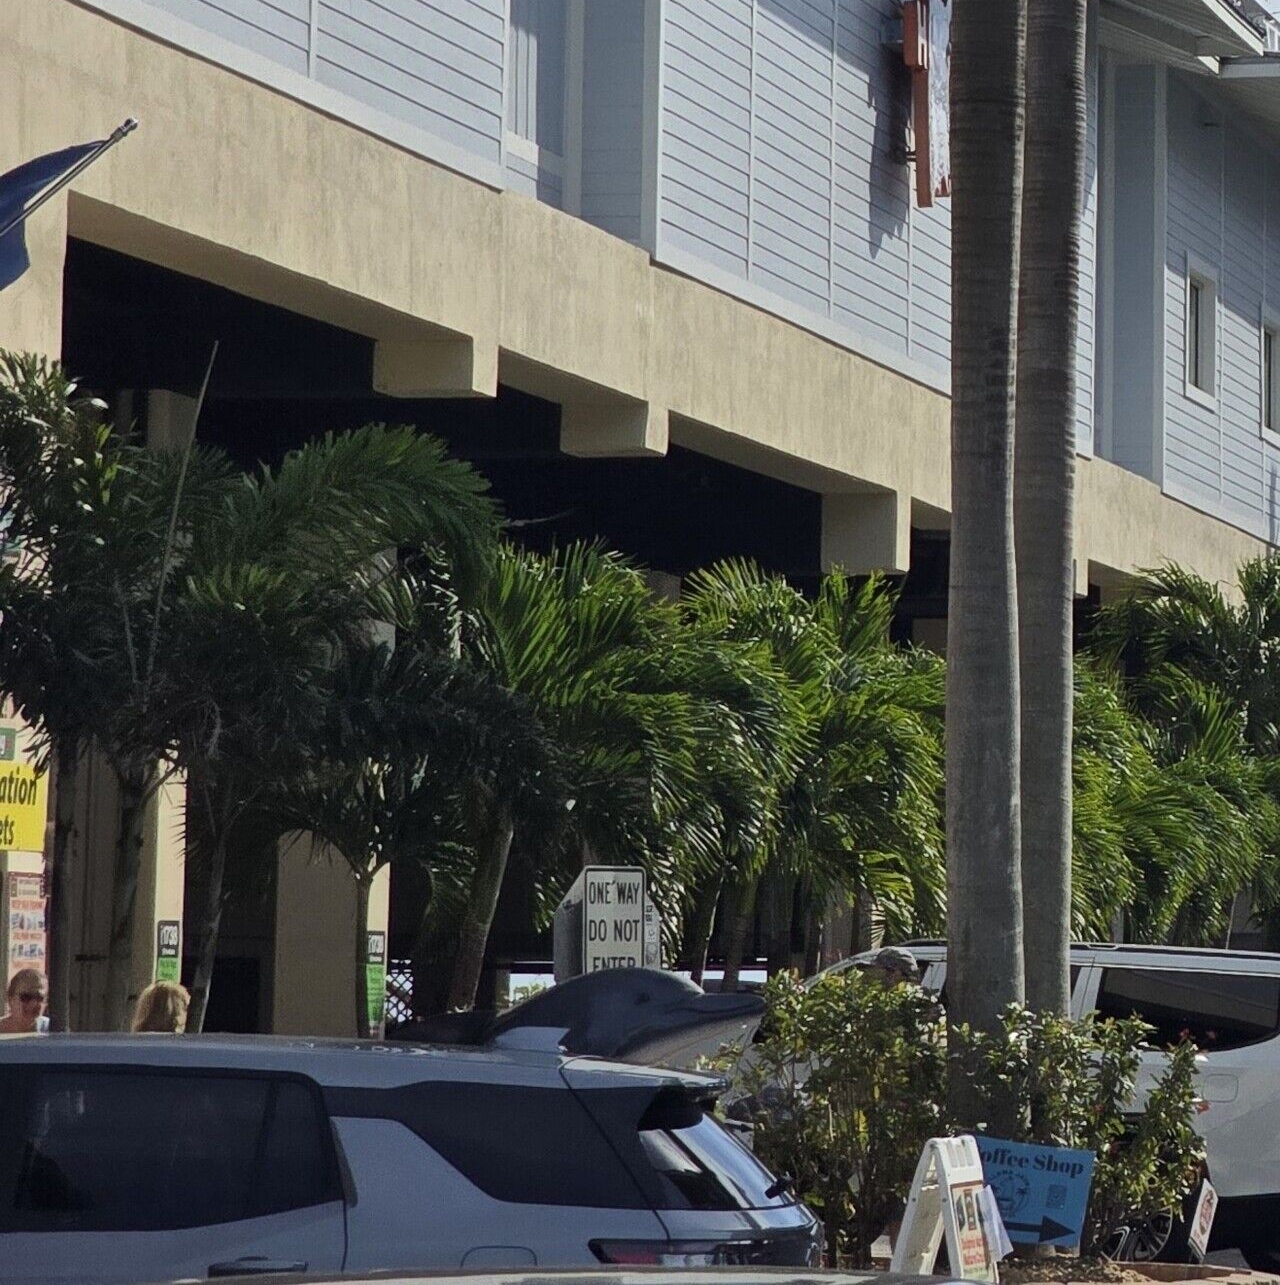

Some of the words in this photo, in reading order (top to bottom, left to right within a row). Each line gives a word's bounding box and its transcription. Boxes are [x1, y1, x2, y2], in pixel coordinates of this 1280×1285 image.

[589, 882, 611, 904] ONE
[616, 882, 640, 904] WAY
[589, 919, 607, 942] DO
[613, 919, 640, 942] NOT
[980, 1147, 1029, 1169] offee
[1032, 1153, 1085, 1178] Shop
